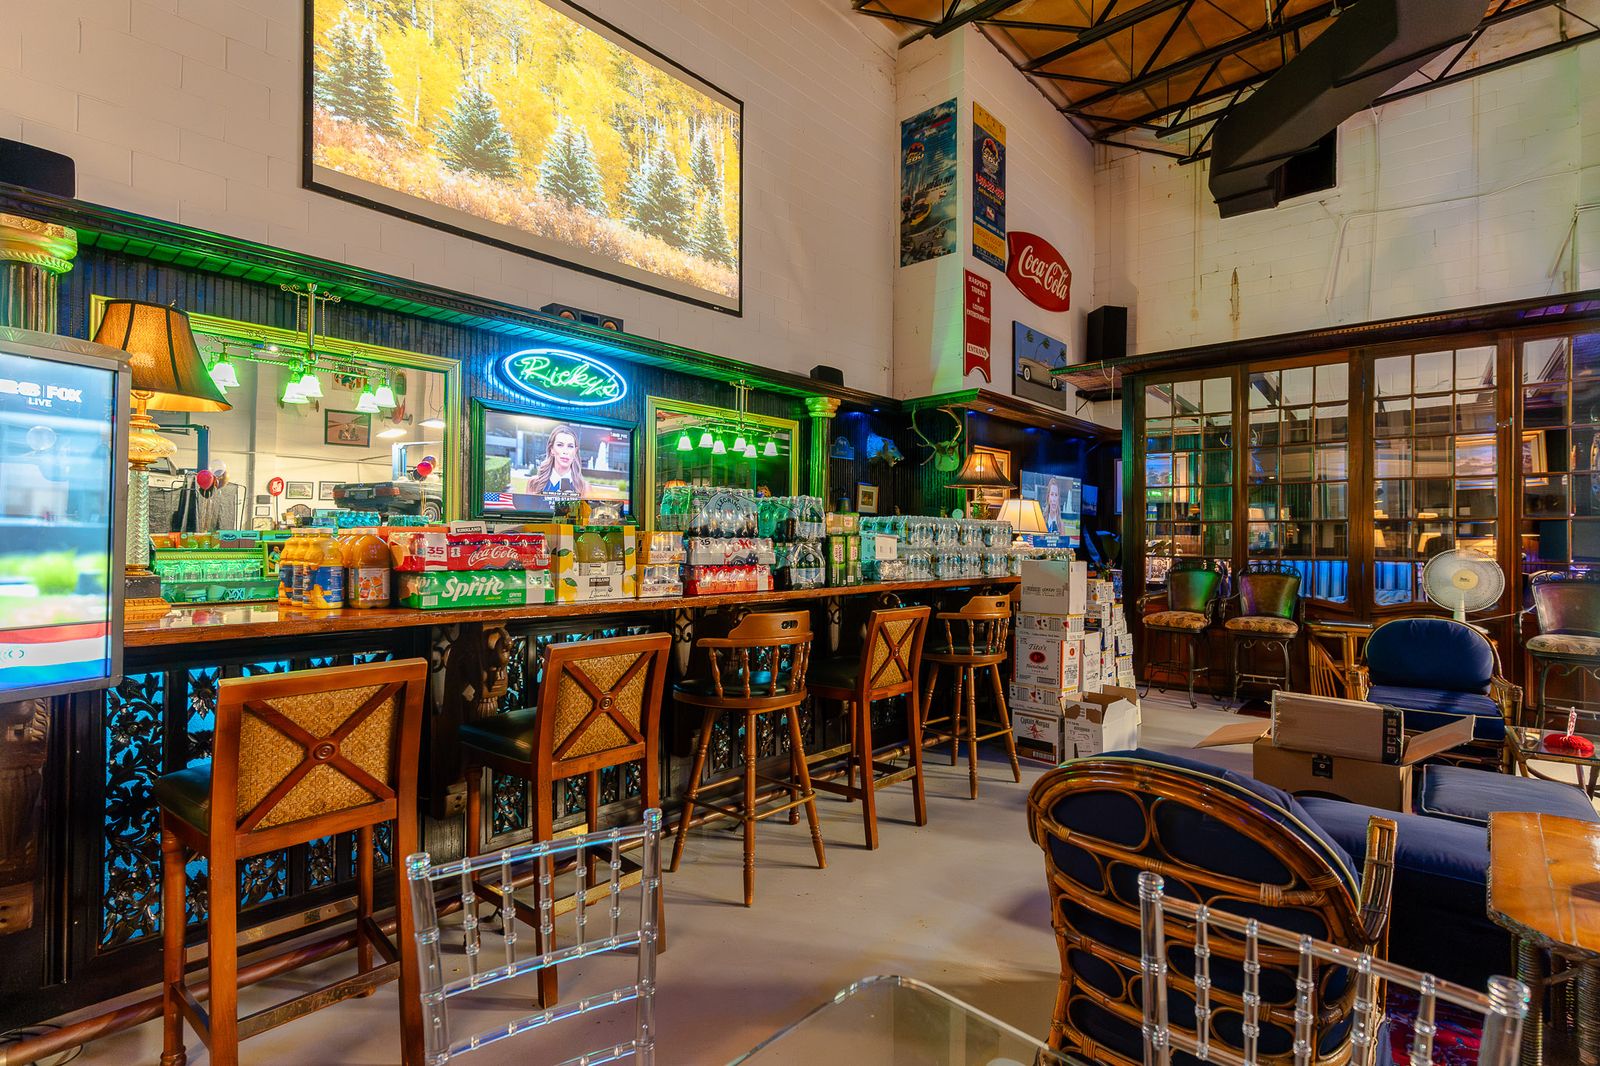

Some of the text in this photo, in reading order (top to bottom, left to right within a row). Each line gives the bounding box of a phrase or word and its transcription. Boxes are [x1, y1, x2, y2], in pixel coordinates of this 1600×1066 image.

[514, 356, 619, 398] Ricky's
[46, 385, 82, 403] FOX
[28, 397, 52, 408] LIVE
[427, 546, 444, 555] 35
[441, 576, 505, 602] Sprite
[1028, 643, 1047, 651] Tito's
